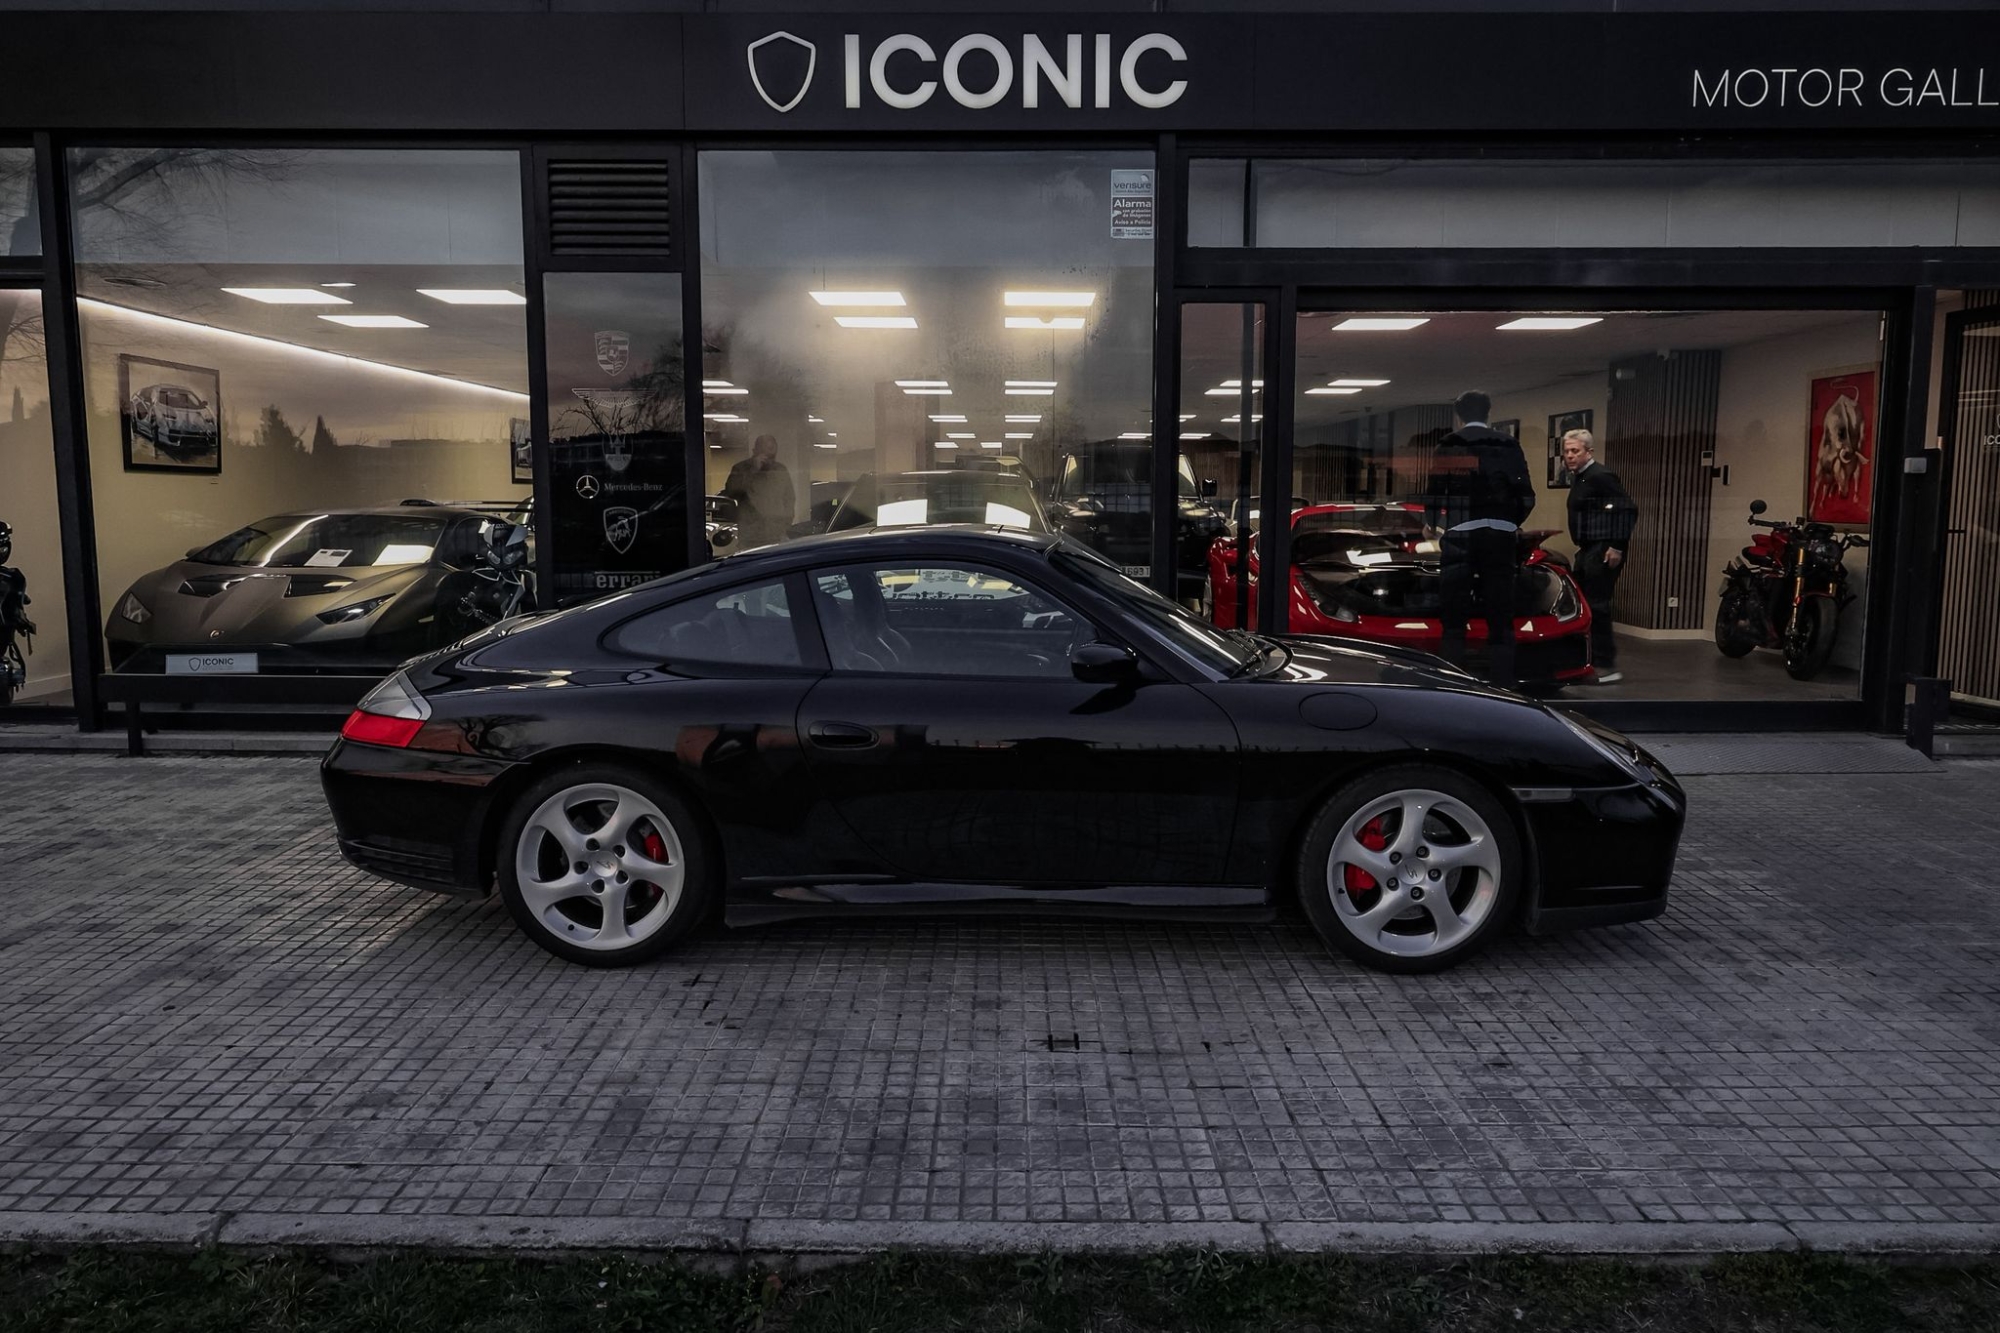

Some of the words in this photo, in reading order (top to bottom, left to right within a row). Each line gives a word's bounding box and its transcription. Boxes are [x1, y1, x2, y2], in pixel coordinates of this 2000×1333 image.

[844, 32, 1188, 109] ICONIC
[1692, 68, 1864, 107] MOTOR
[1880, 68, 2000, 107] GALL
[1114, 199, 1151, 207] Alarma
[603, 482, 663, 492] Mercedes-Benz
[202, 657, 234, 666] ICONIC
